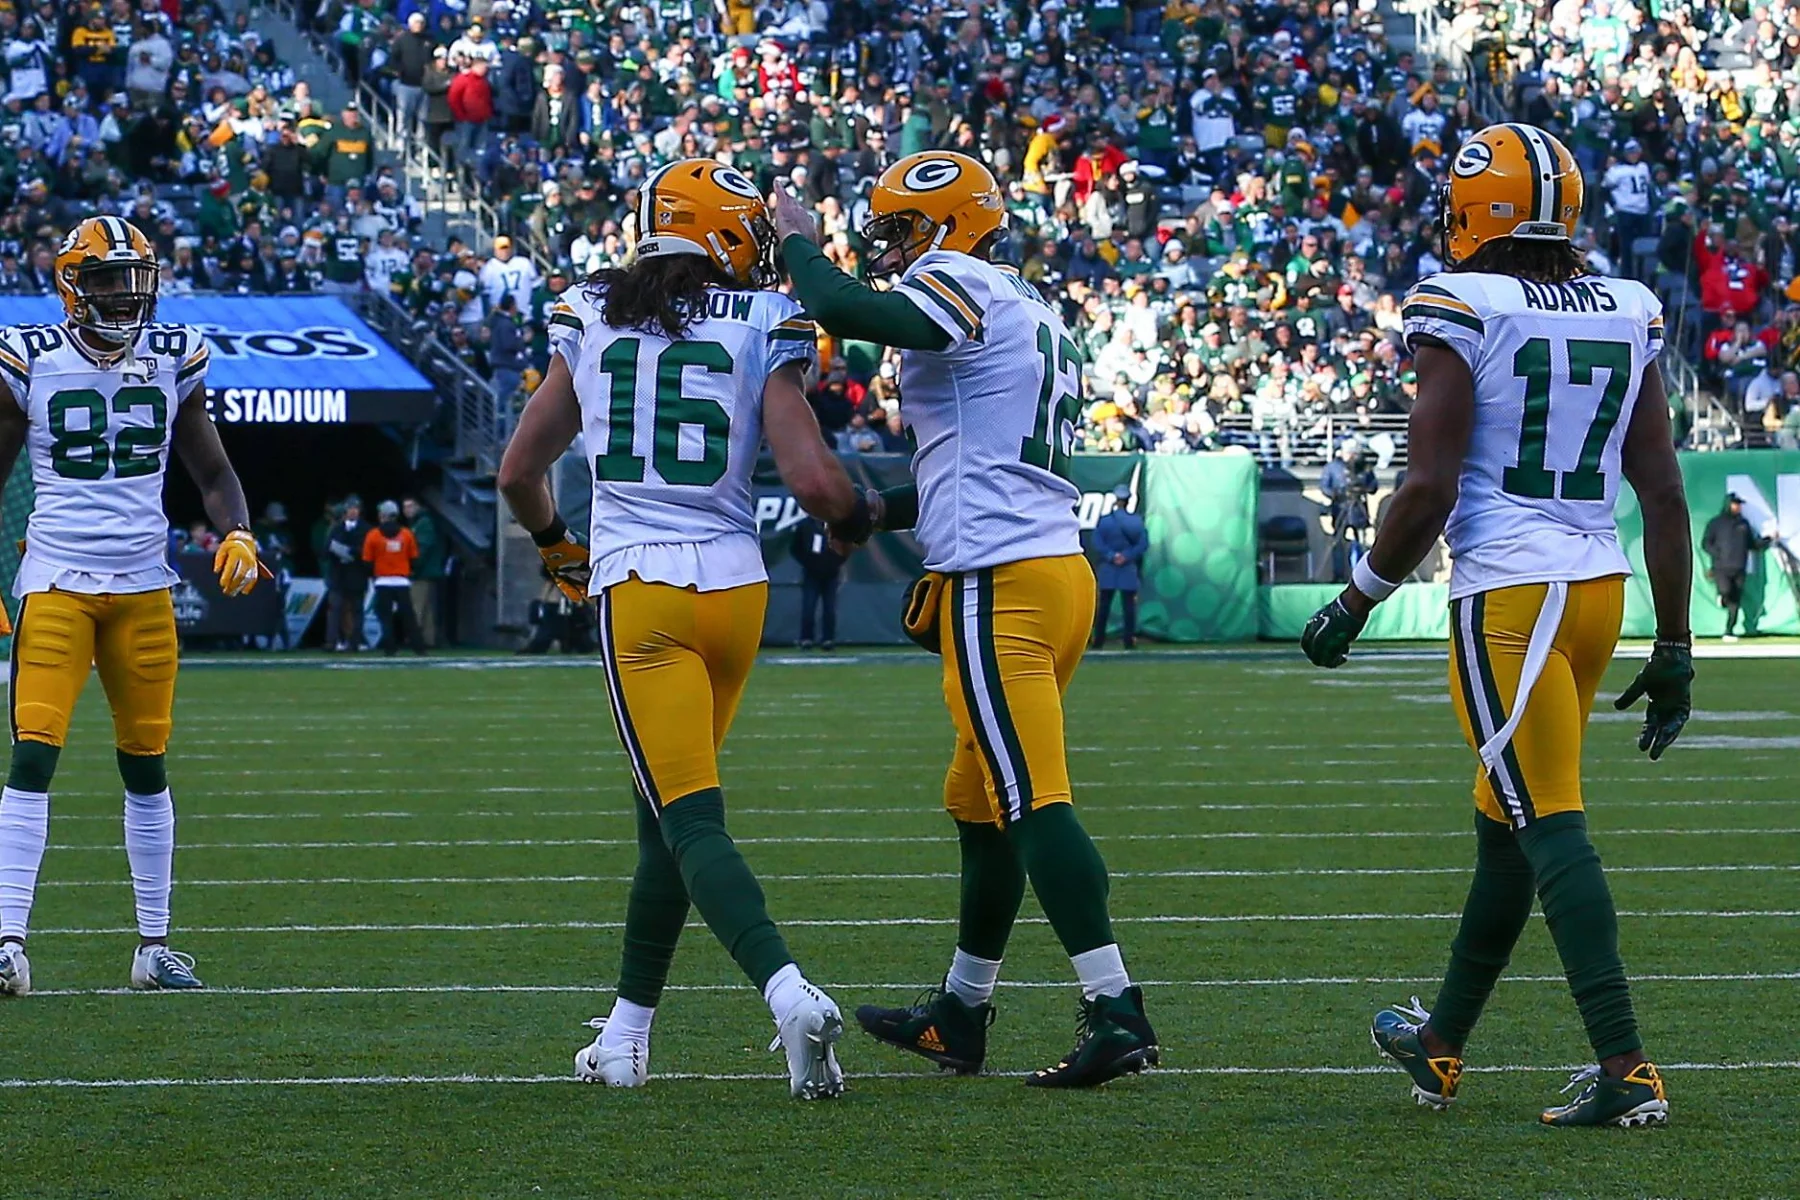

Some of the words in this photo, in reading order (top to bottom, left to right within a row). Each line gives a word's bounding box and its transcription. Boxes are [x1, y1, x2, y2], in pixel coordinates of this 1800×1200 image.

[1521, 278, 1617, 313] ADAMS
[203, 329, 371, 357] TOS
[48, 386, 167, 480] 82
[223, 388, 347, 423] STADIUM
[596, 337, 733, 486] 16
[1019, 321, 1084, 482] 12
[1503, 338, 1632, 500] 17
